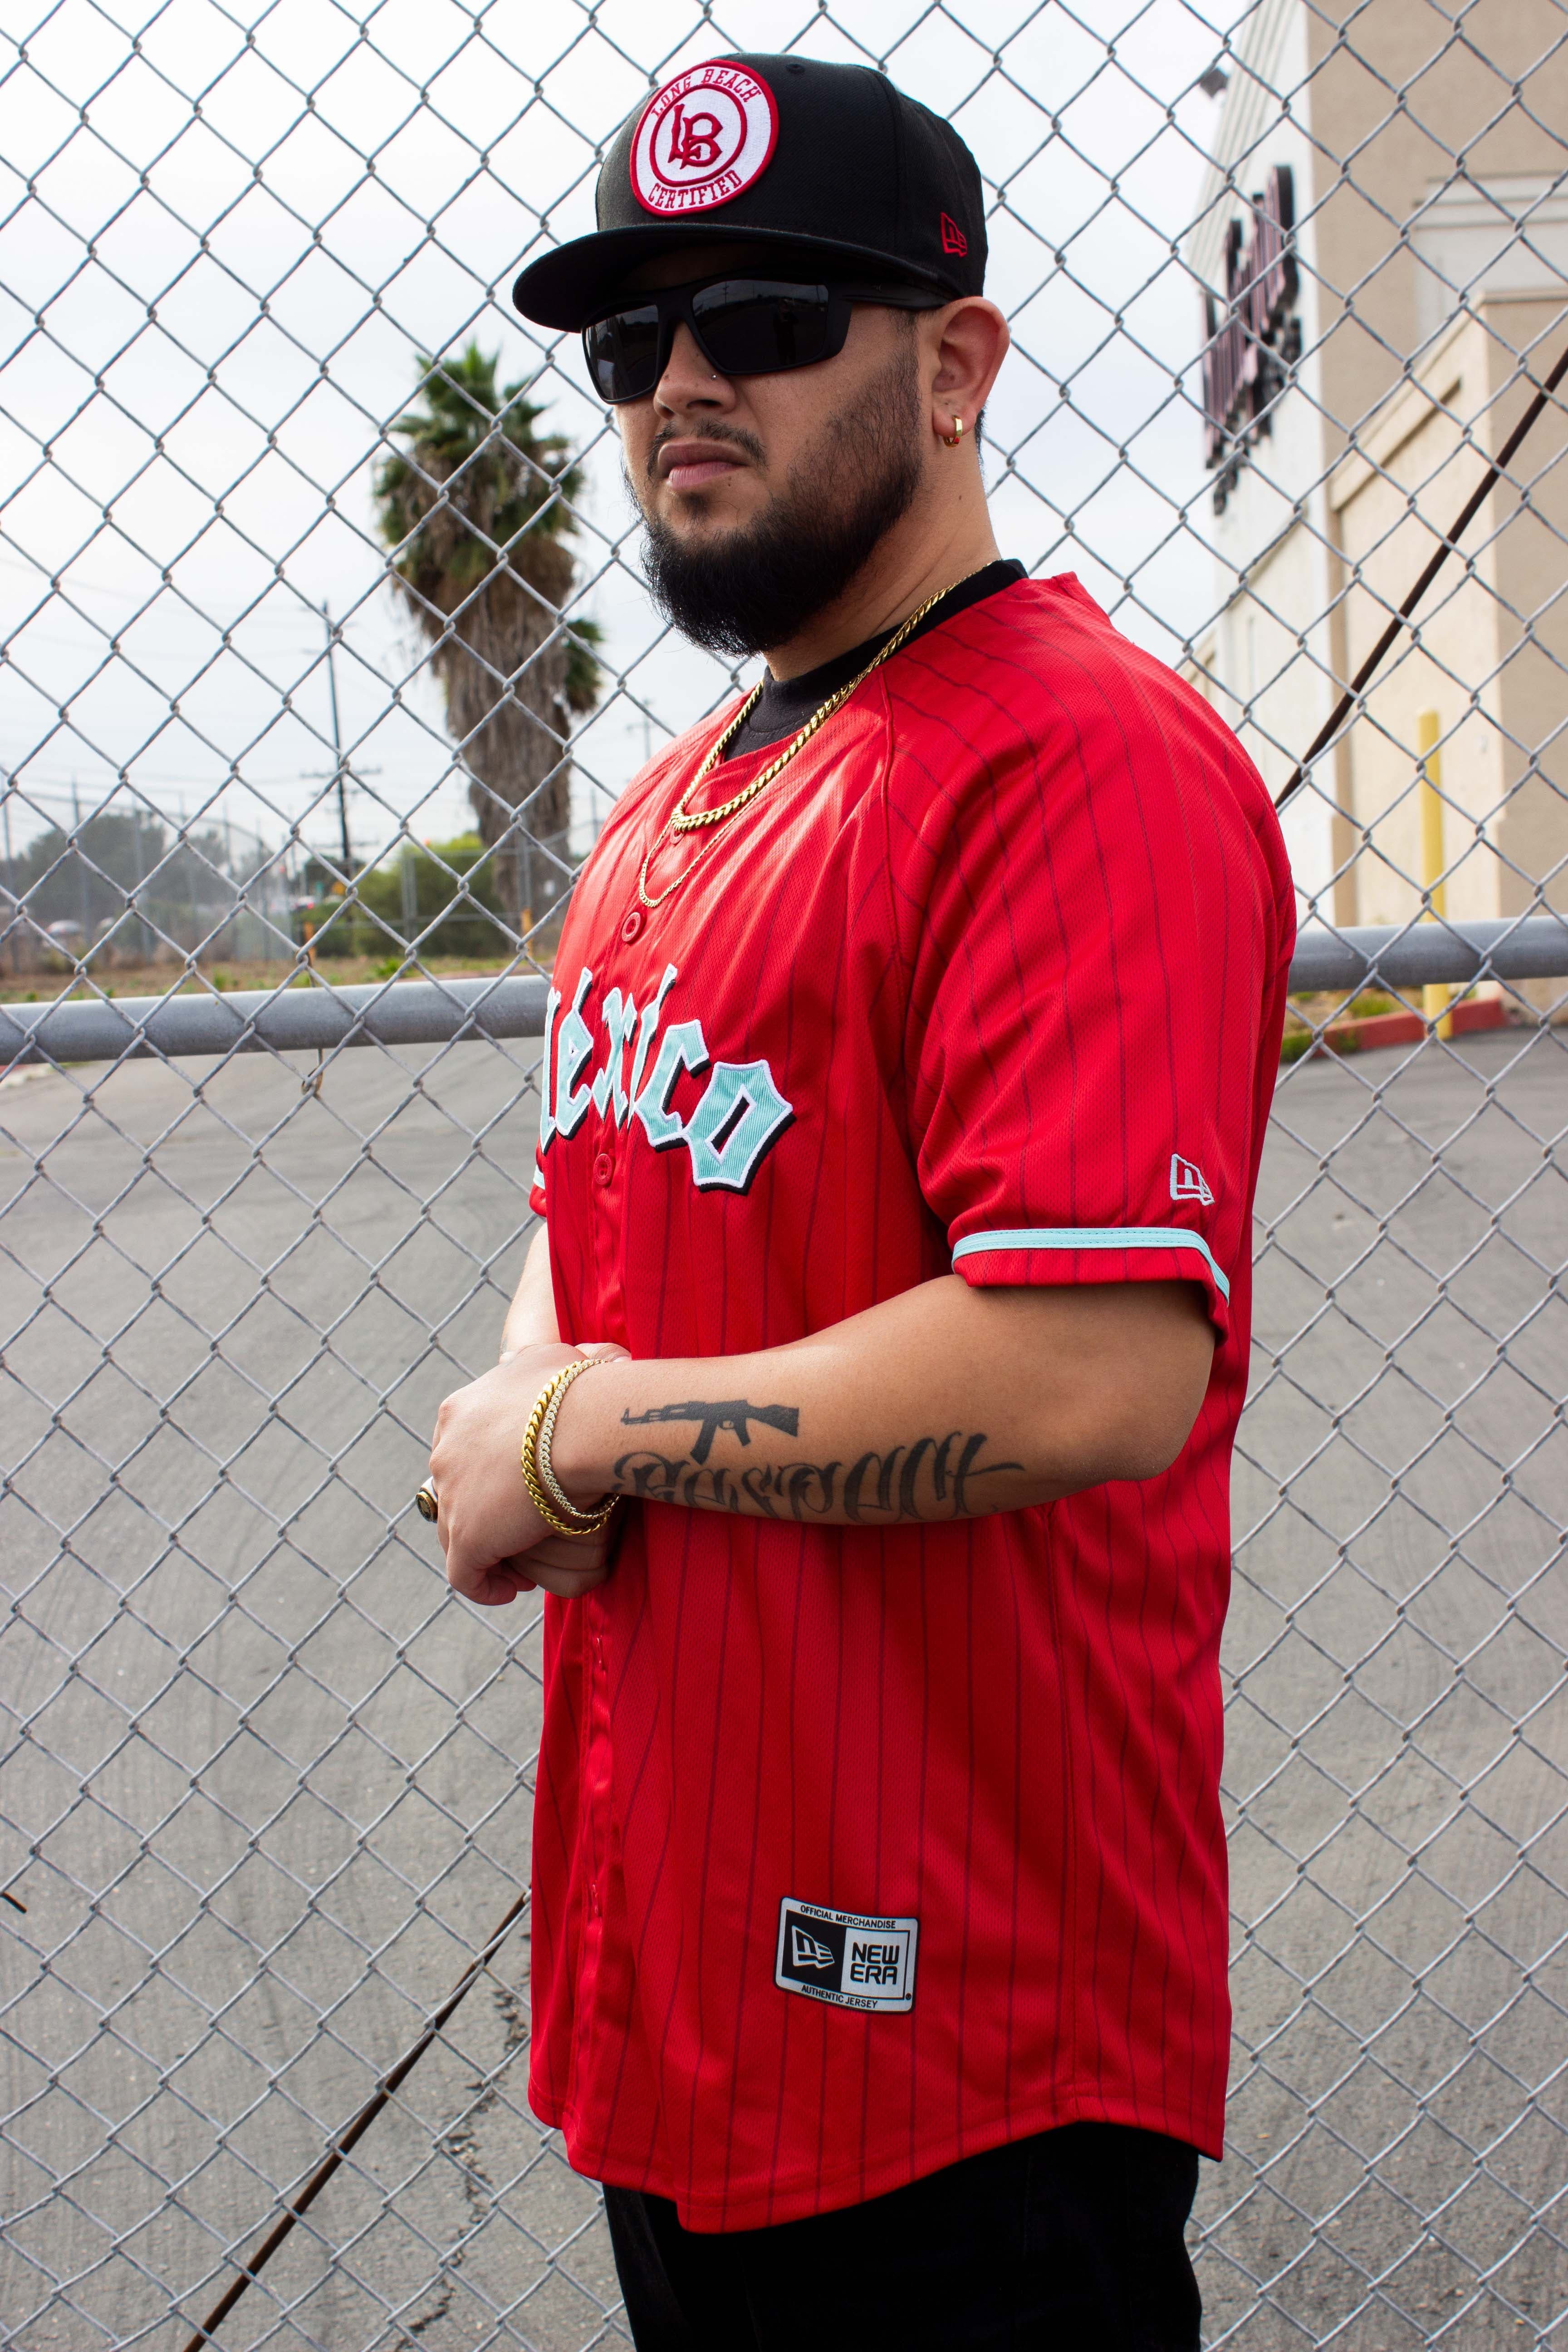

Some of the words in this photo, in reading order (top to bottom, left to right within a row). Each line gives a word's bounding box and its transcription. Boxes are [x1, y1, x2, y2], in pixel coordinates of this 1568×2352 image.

[651, 76, 691, 117] LONG
[701, 69, 762, 103] BEACH
[648, 170, 742, 209] CERTIFIED
[540, 963, 797, 1196] éxico
[800, 1905, 833, 1921] OFFICIAL
[835, 1914, 896, 1929] MERCHANDISE
[851, 1941, 900, 1965] NEW
[850, 1963, 898, 1985] ERA
[801, 1984, 844, 2003] AUTHENTIC
[845, 1996, 878, 2009] JERSEY
